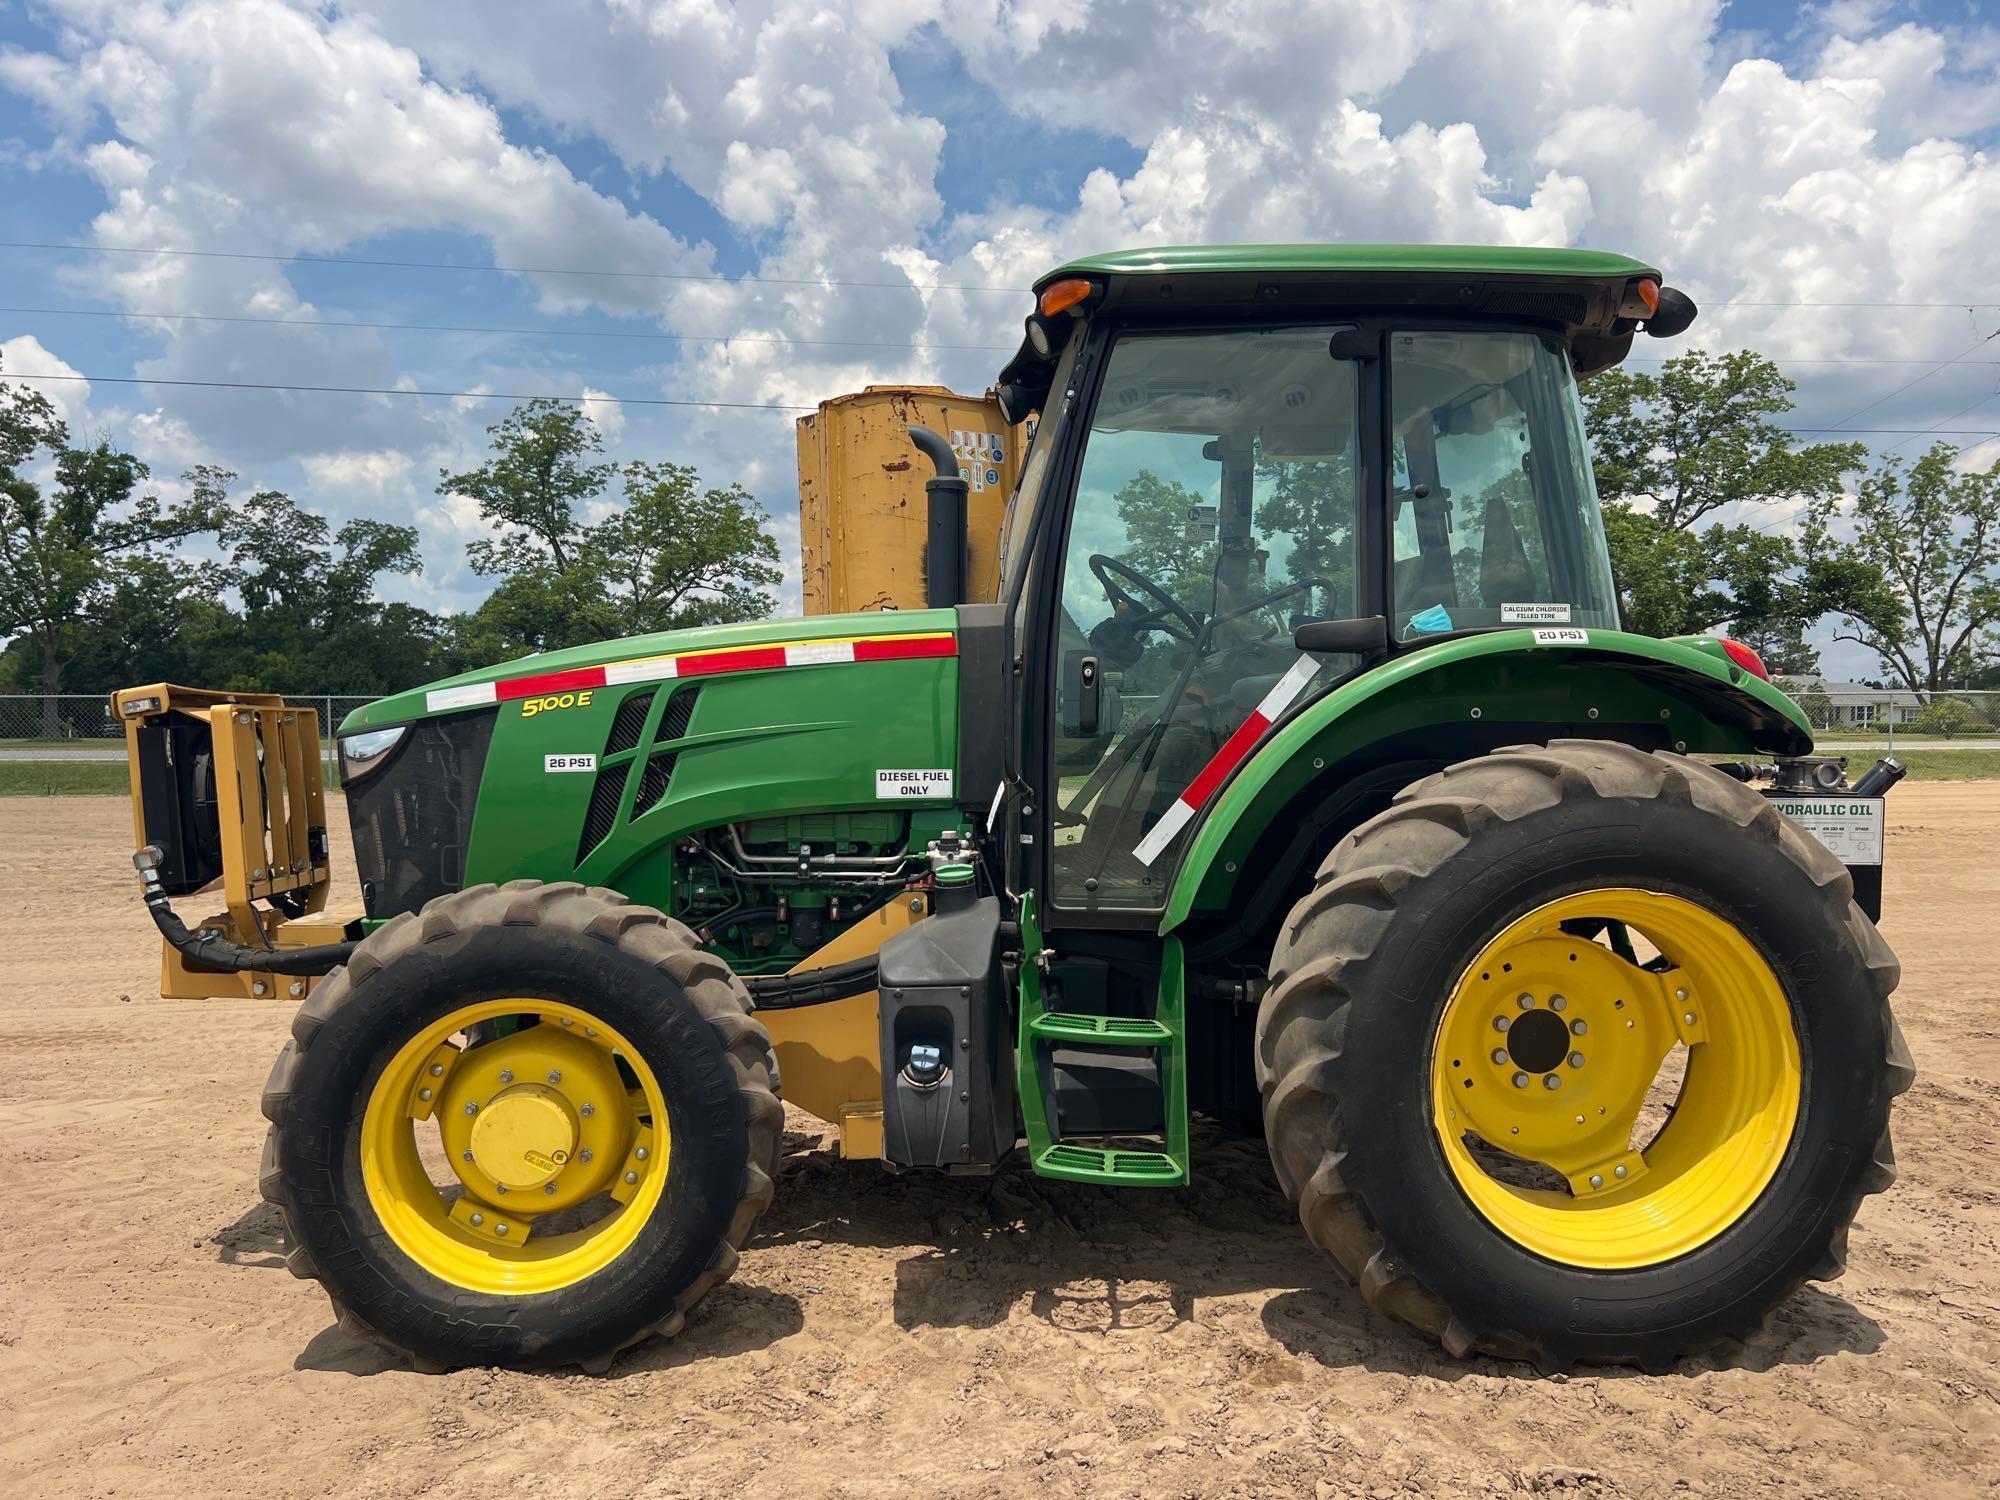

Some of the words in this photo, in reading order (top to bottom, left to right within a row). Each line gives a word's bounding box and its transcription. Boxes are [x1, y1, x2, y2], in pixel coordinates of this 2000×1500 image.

[1538, 631, 1557, 640] 20
[1559, 630, 1584, 640] PSI
[521, 693, 576, 717] 5100
[577, 691, 594, 707] E
[549, 758, 566, 768] 26
[569, 757, 592, 768] PSI
[879, 772, 920, 782] DIESEL
[923, 772, 950, 782] FUEL
[900, 785, 929, 795] ONLY
[1773, 804, 1846, 816] YDRAULIC
[1849, 804, 1873, 816] OIL
